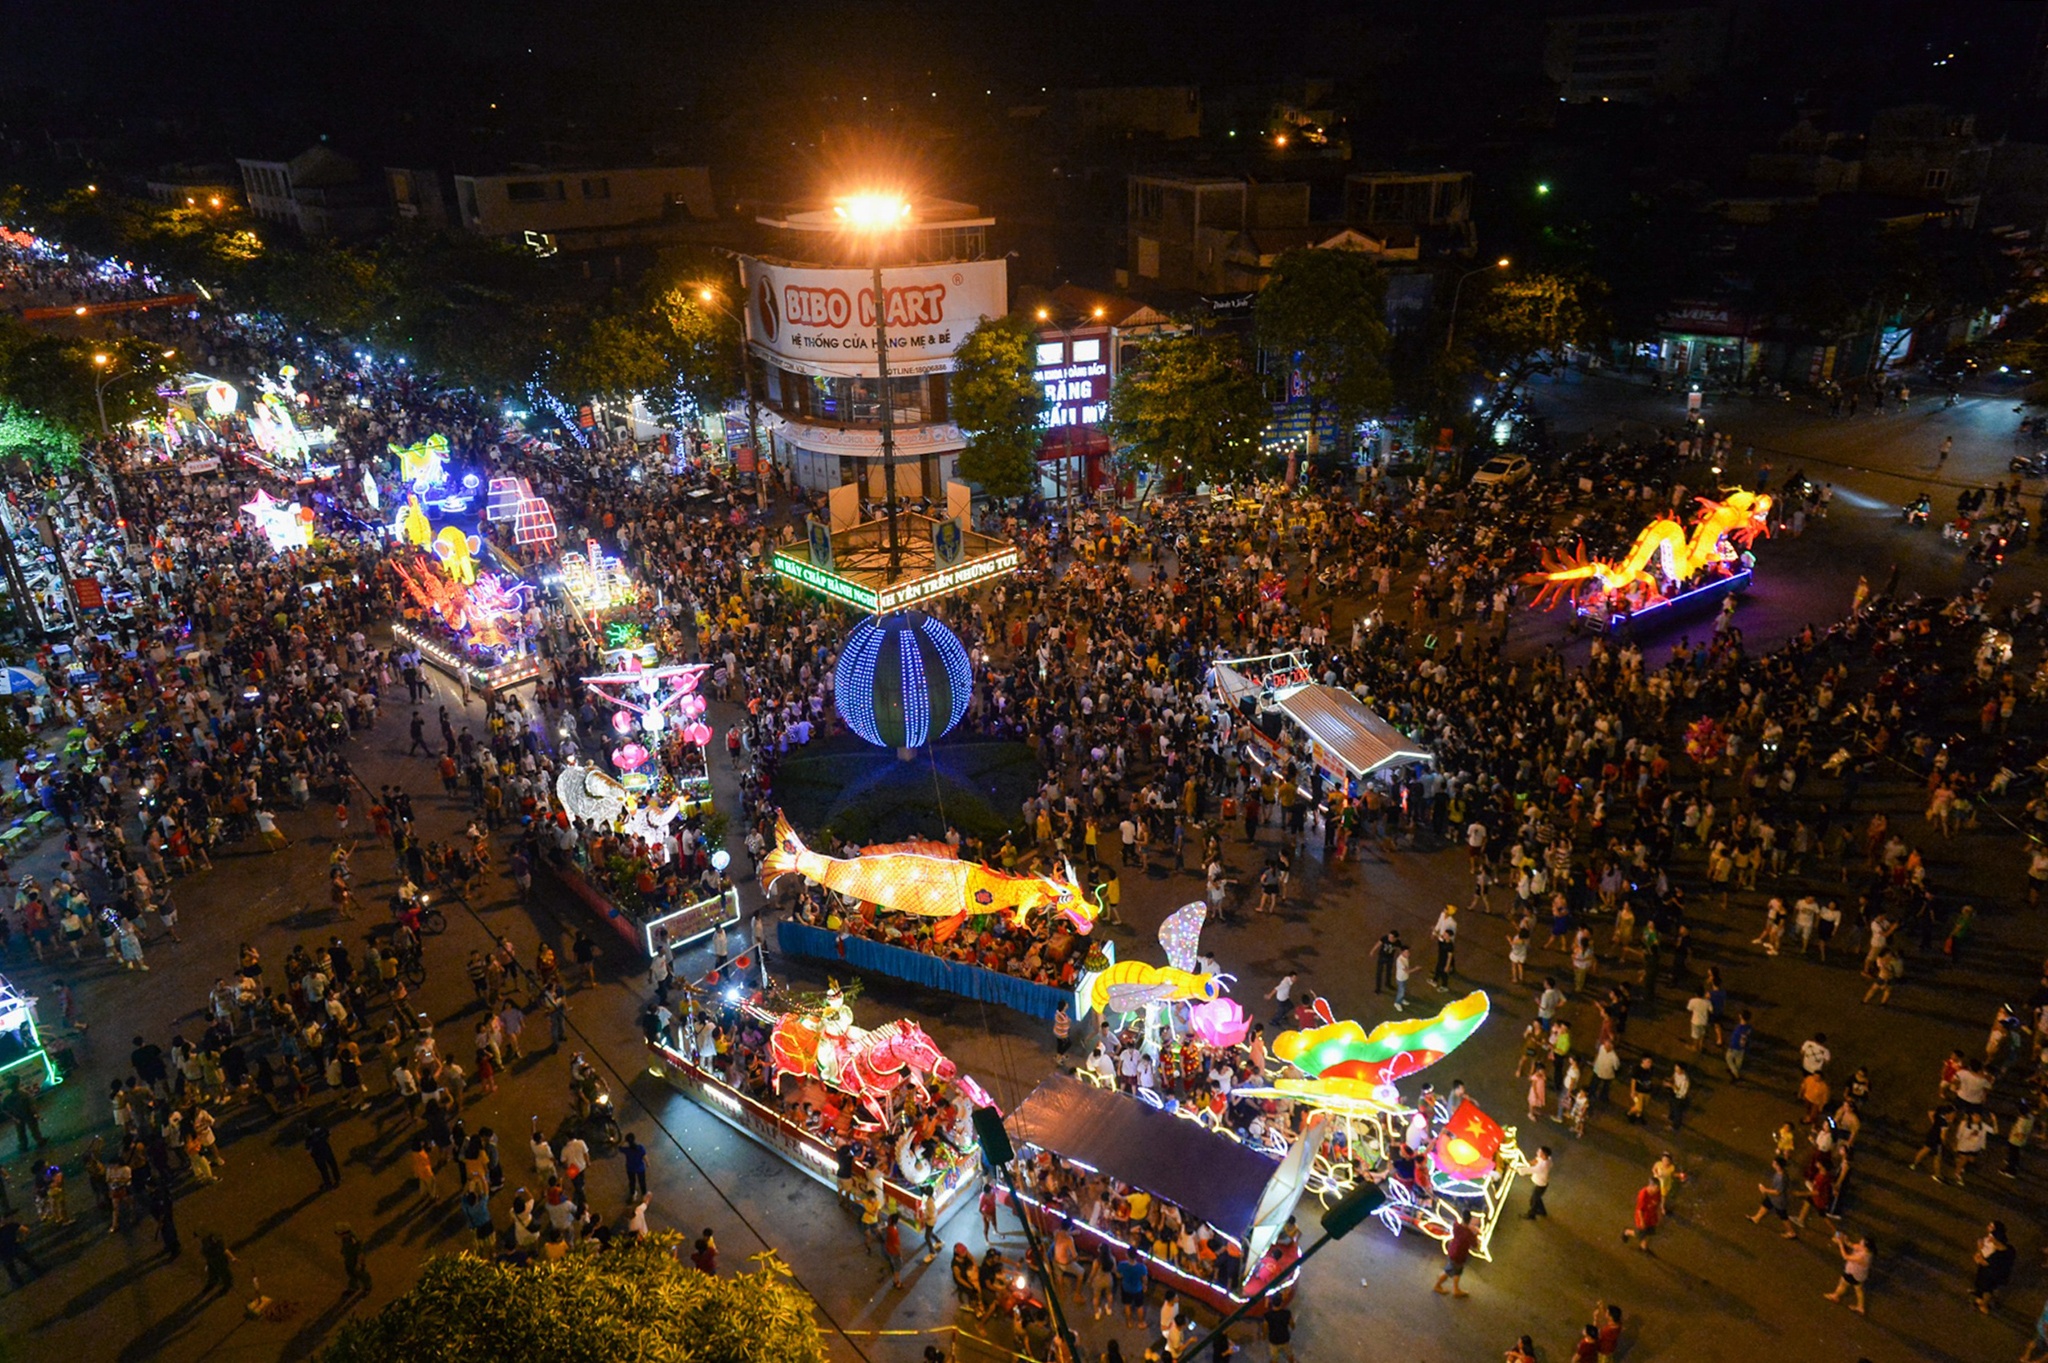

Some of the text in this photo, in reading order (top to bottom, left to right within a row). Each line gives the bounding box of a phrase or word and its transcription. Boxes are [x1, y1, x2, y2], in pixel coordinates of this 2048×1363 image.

[785, 284, 946, 328] BIBO MART
[791, 334, 802, 349] HỆ
[804, 333, 839, 349] THỐNG
[843, 333, 867, 349] CỬA
[911, 336, 926, 349] MẸ
[928, 334, 936, 345] &
[939, 329, 951, 344] BÉ
[1044, 379, 1092, 402] RĂNG
[1082, 401, 1108, 424] MỸ
[785, 560, 803, 578] HÃY
[827, 578, 853, 598] HÀNH
[897, 584, 921, 603] YÊN
[922, 573, 953, 594] TRÊN
